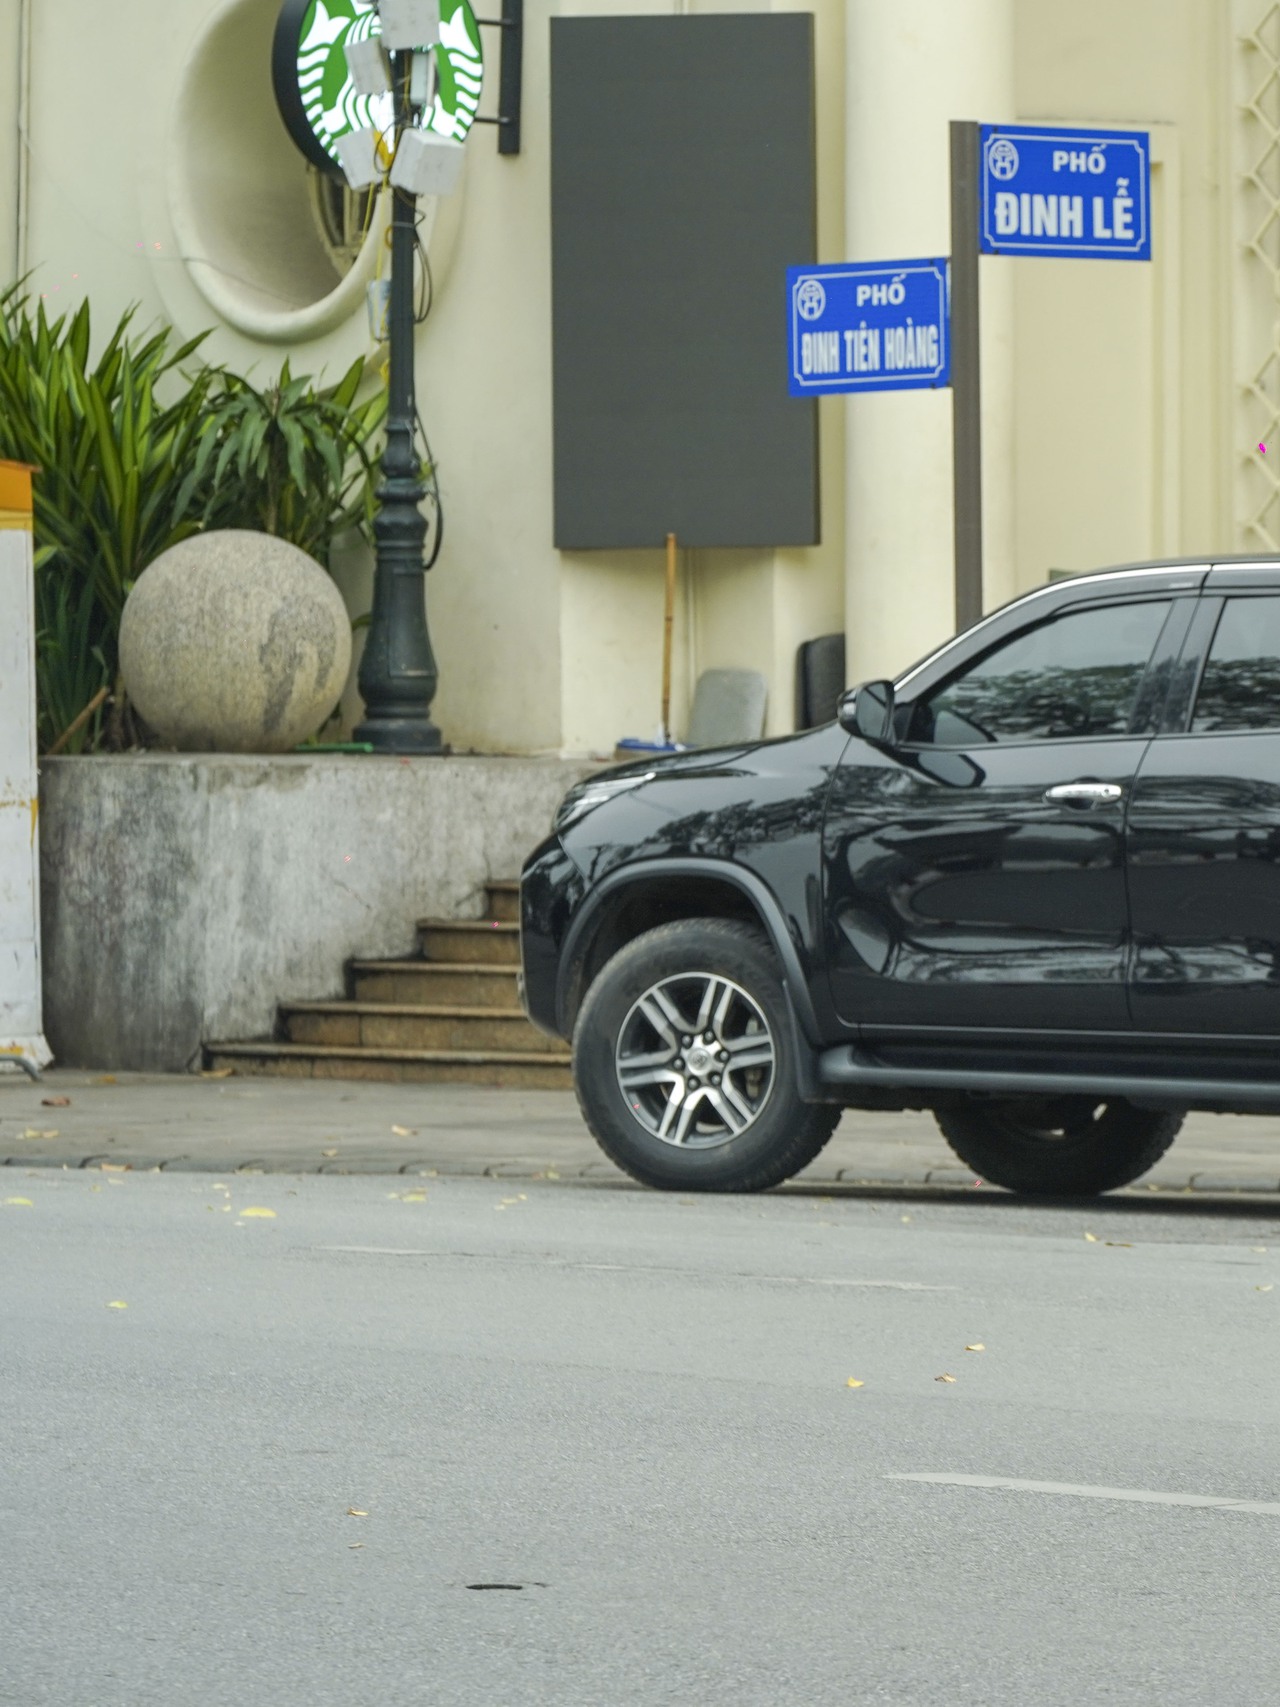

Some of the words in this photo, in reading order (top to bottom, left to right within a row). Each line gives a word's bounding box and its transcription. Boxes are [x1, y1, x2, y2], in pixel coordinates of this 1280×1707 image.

[1052, 143, 1107, 174] PHỐ
[994, 192, 1084, 238] ĐINH
[1093, 177, 1135, 240] LỄ
[856, 273, 907, 308] PHỐ
[801, 330, 841, 376] ĐINH
[844, 320, 881, 373] TIÊN
[884, 316, 939, 370] HOÀNG
